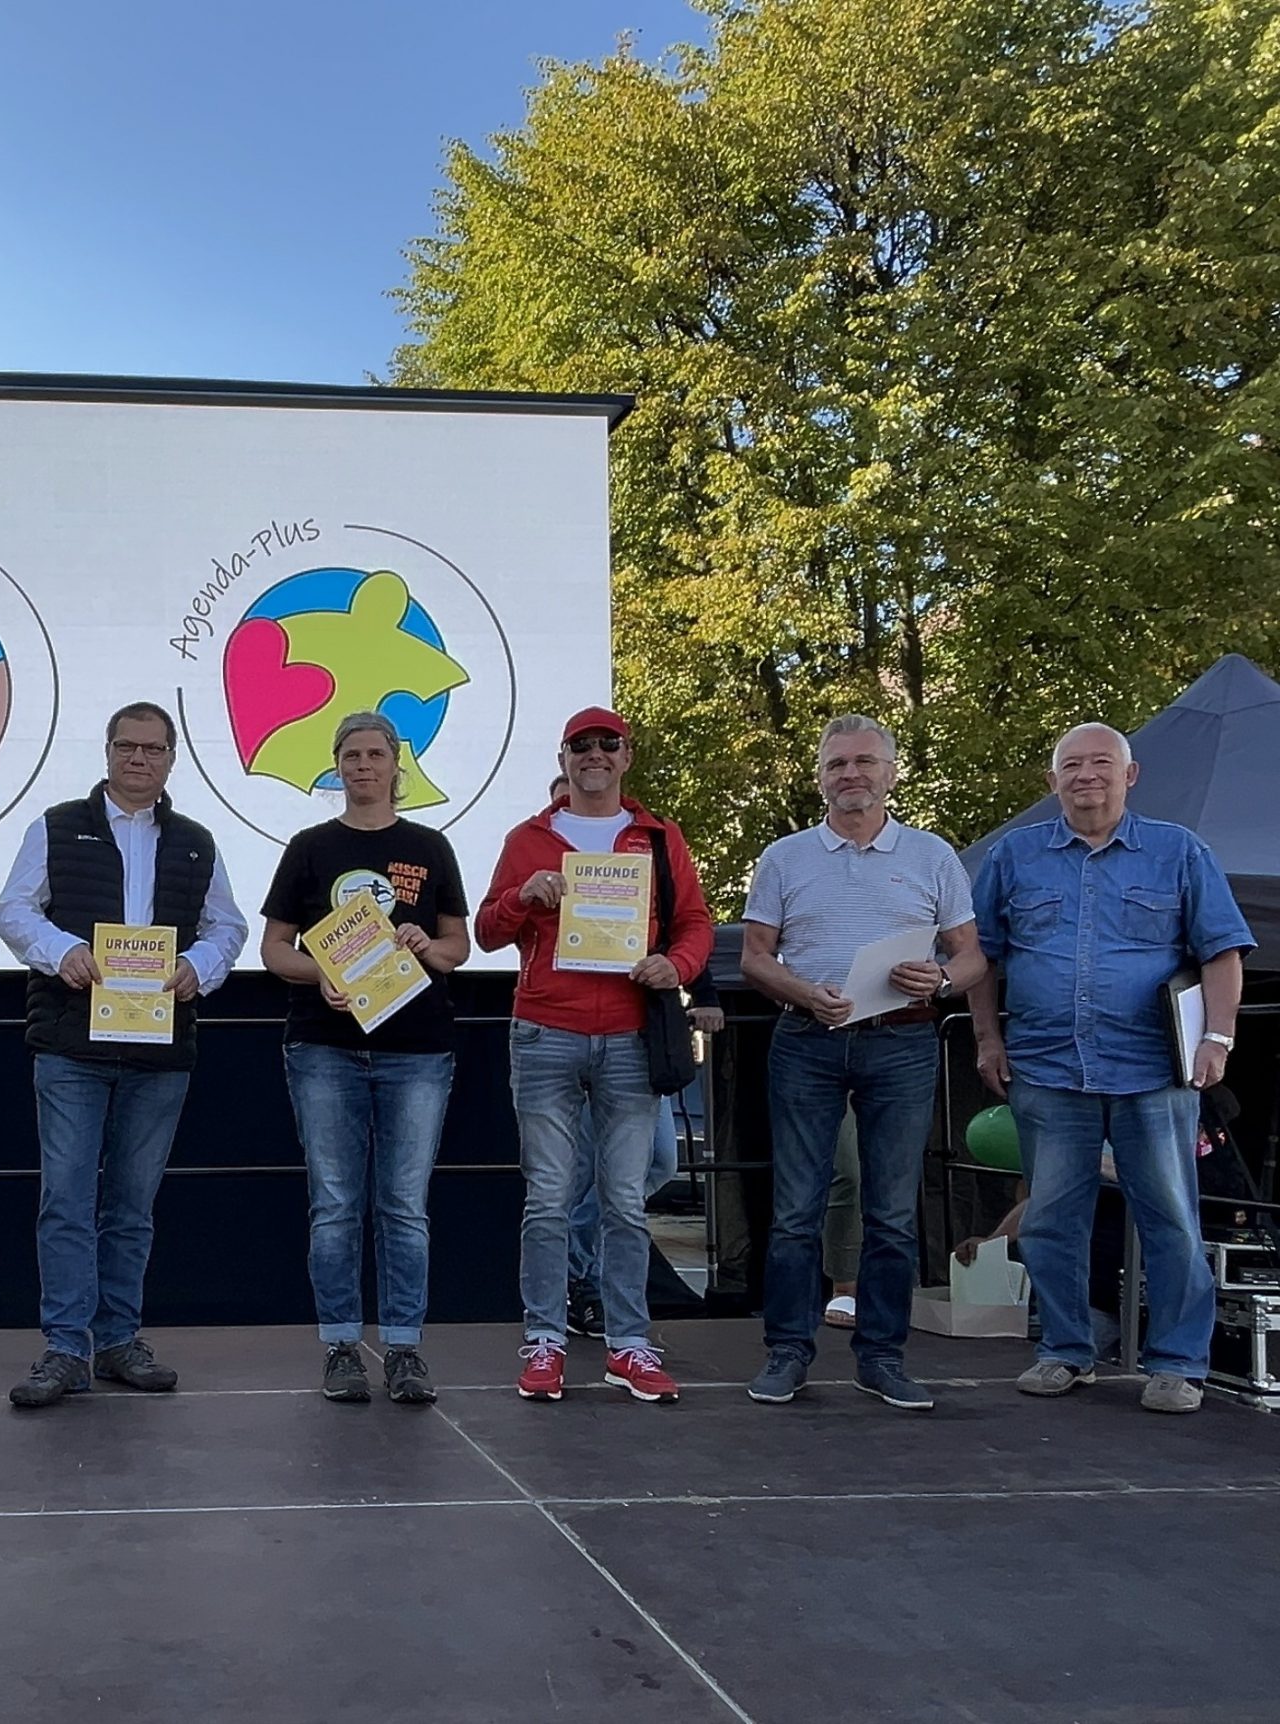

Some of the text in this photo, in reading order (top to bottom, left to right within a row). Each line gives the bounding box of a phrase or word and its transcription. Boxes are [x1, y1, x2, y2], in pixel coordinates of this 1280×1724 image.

[169, 518, 321, 661] Agenda-Plus
[575, 865, 640, 879] URKUNDE
[319, 905, 371, 950] URKUNDE
[106, 938, 166, 952] URKUNDE
